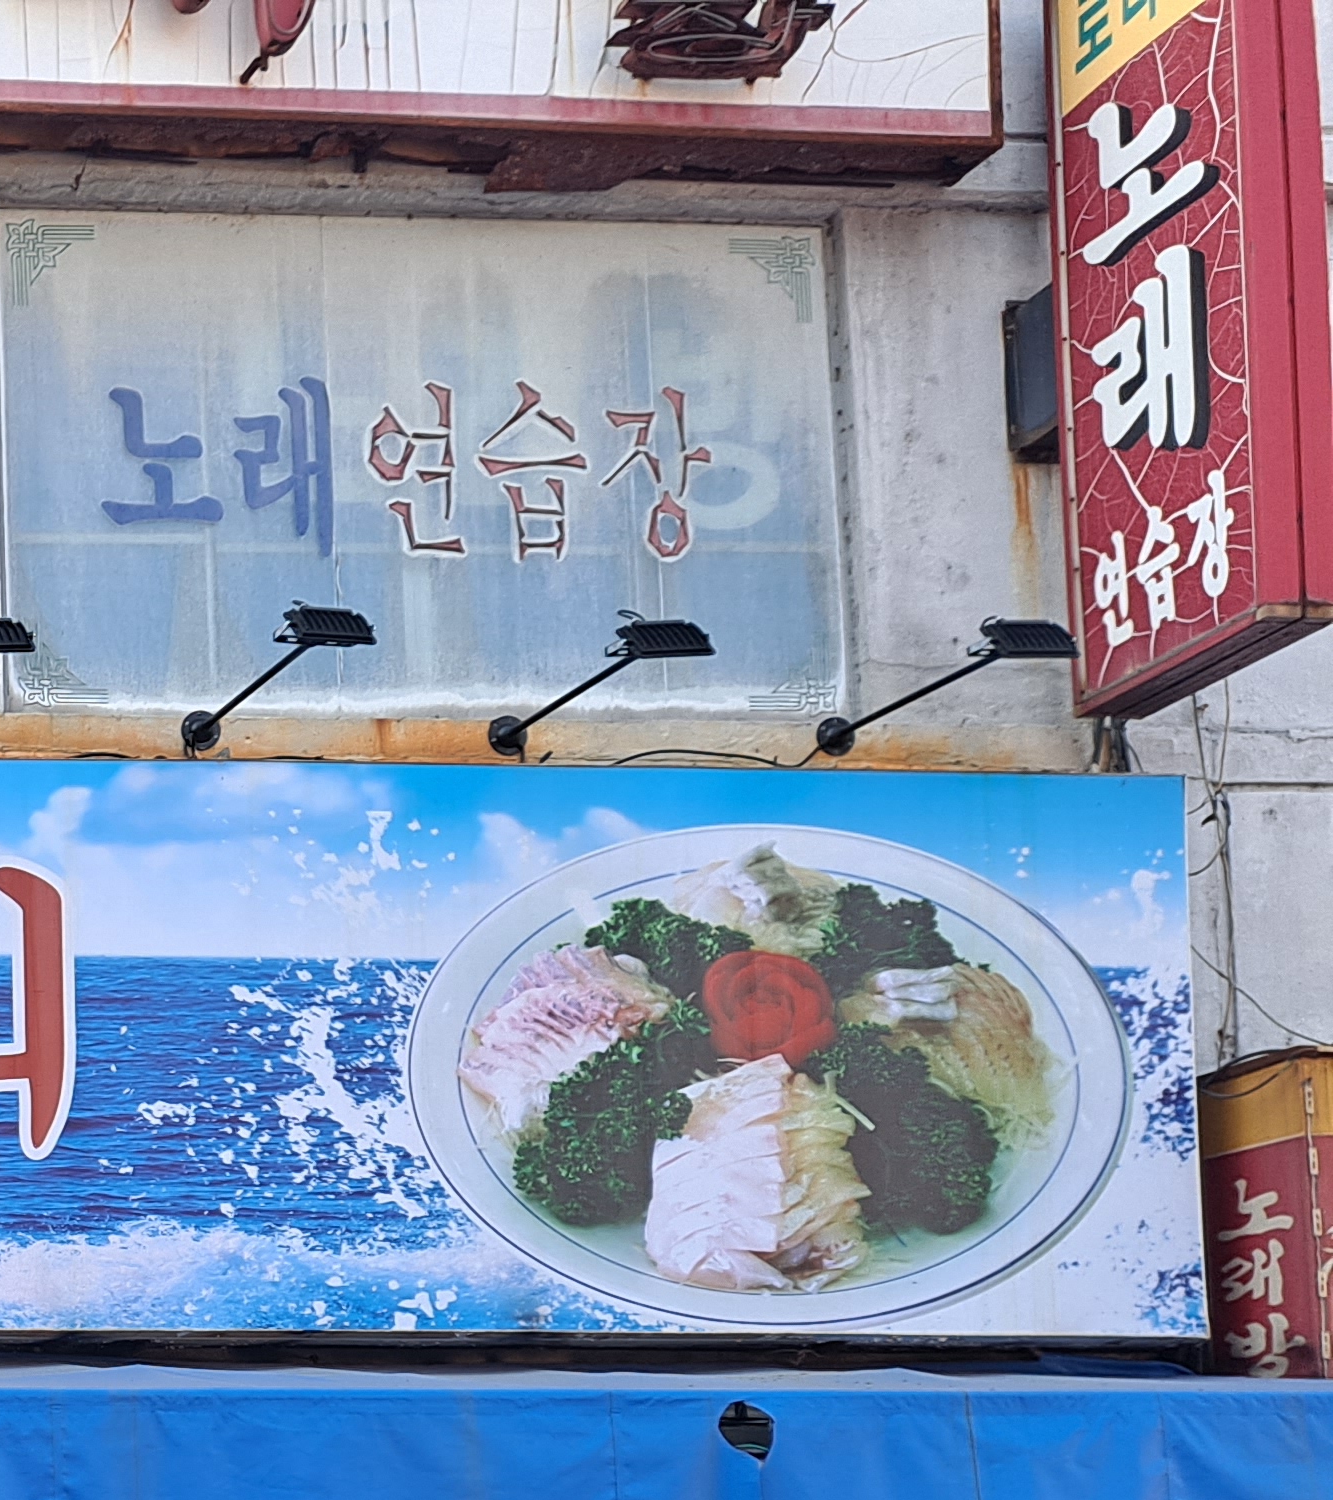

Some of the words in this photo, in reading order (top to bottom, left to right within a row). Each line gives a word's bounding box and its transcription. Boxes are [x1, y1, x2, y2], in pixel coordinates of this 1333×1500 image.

[1082, 102, 1219, 450] 노래
[1093, 469, 1236, 647] 연습장
[1217, 1178, 1307, 1379] 노래방
